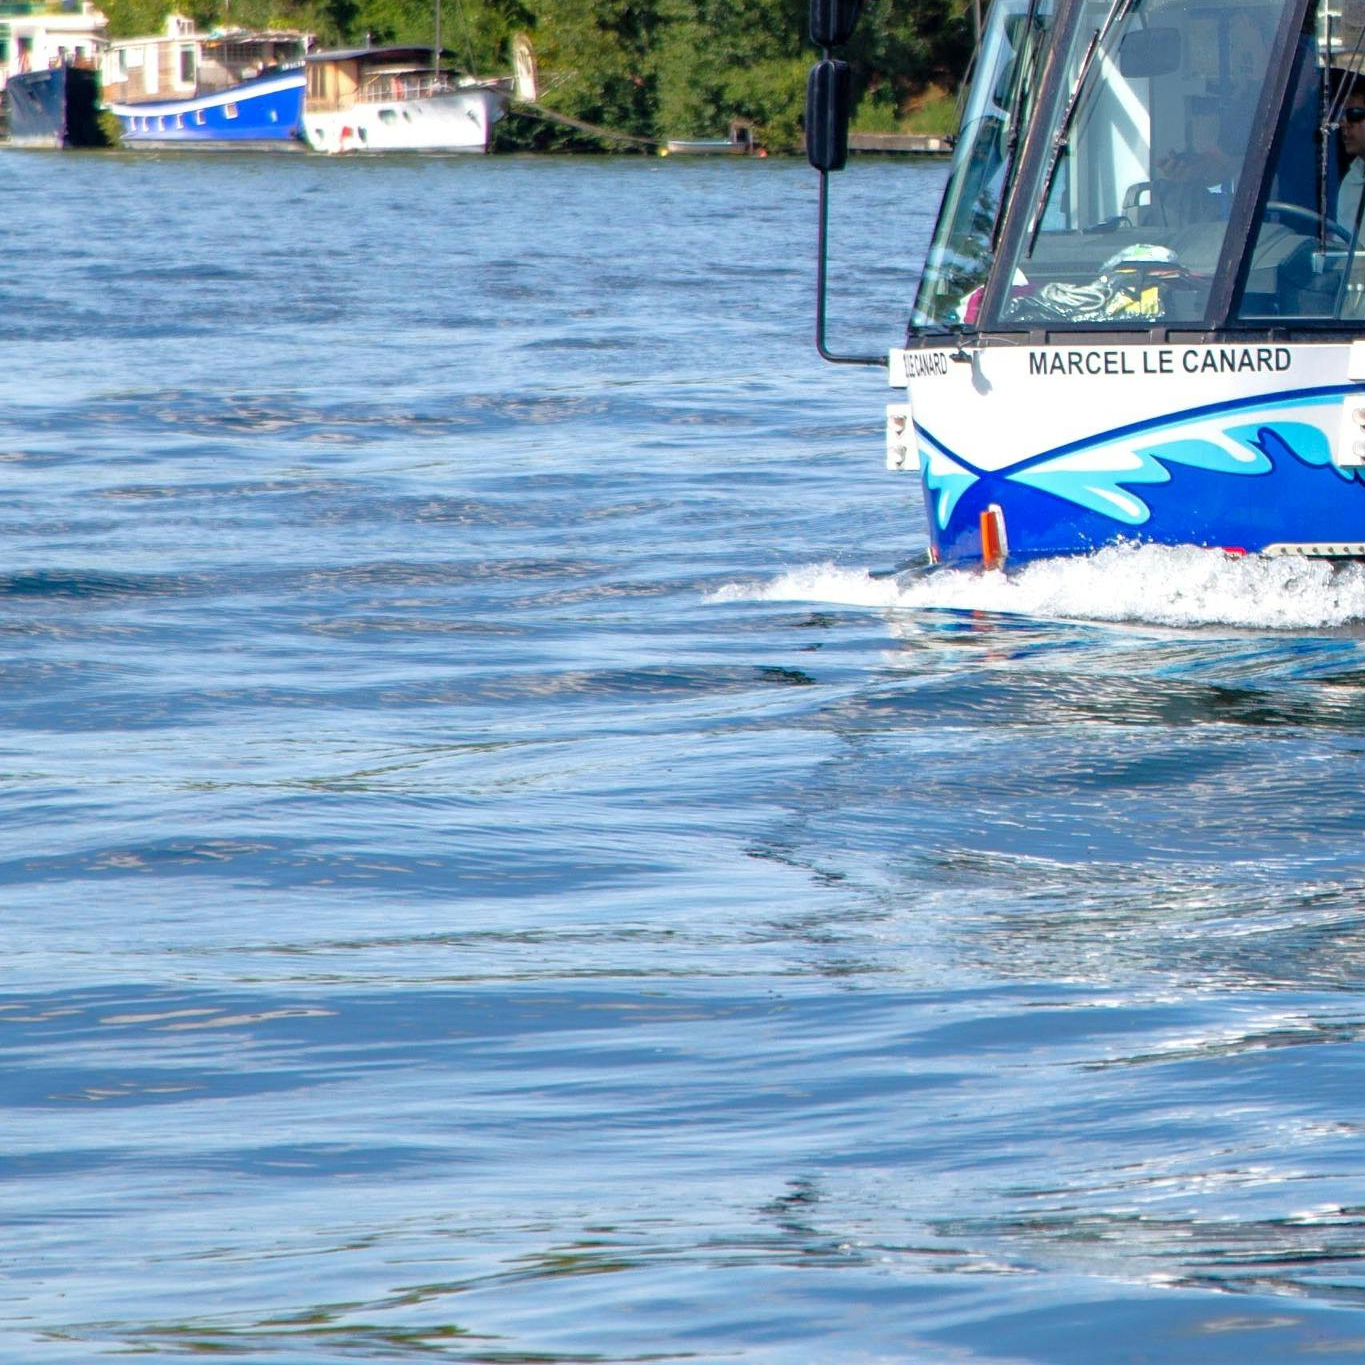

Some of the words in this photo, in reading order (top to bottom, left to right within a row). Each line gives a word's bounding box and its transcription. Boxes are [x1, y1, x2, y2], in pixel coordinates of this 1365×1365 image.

[915, 352, 948, 377] CANARD
[1029, 351, 1134, 375] MARCEL
[1143, 350, 1173, 373] LE
[1182, 348, 1292, 373] CANARD
